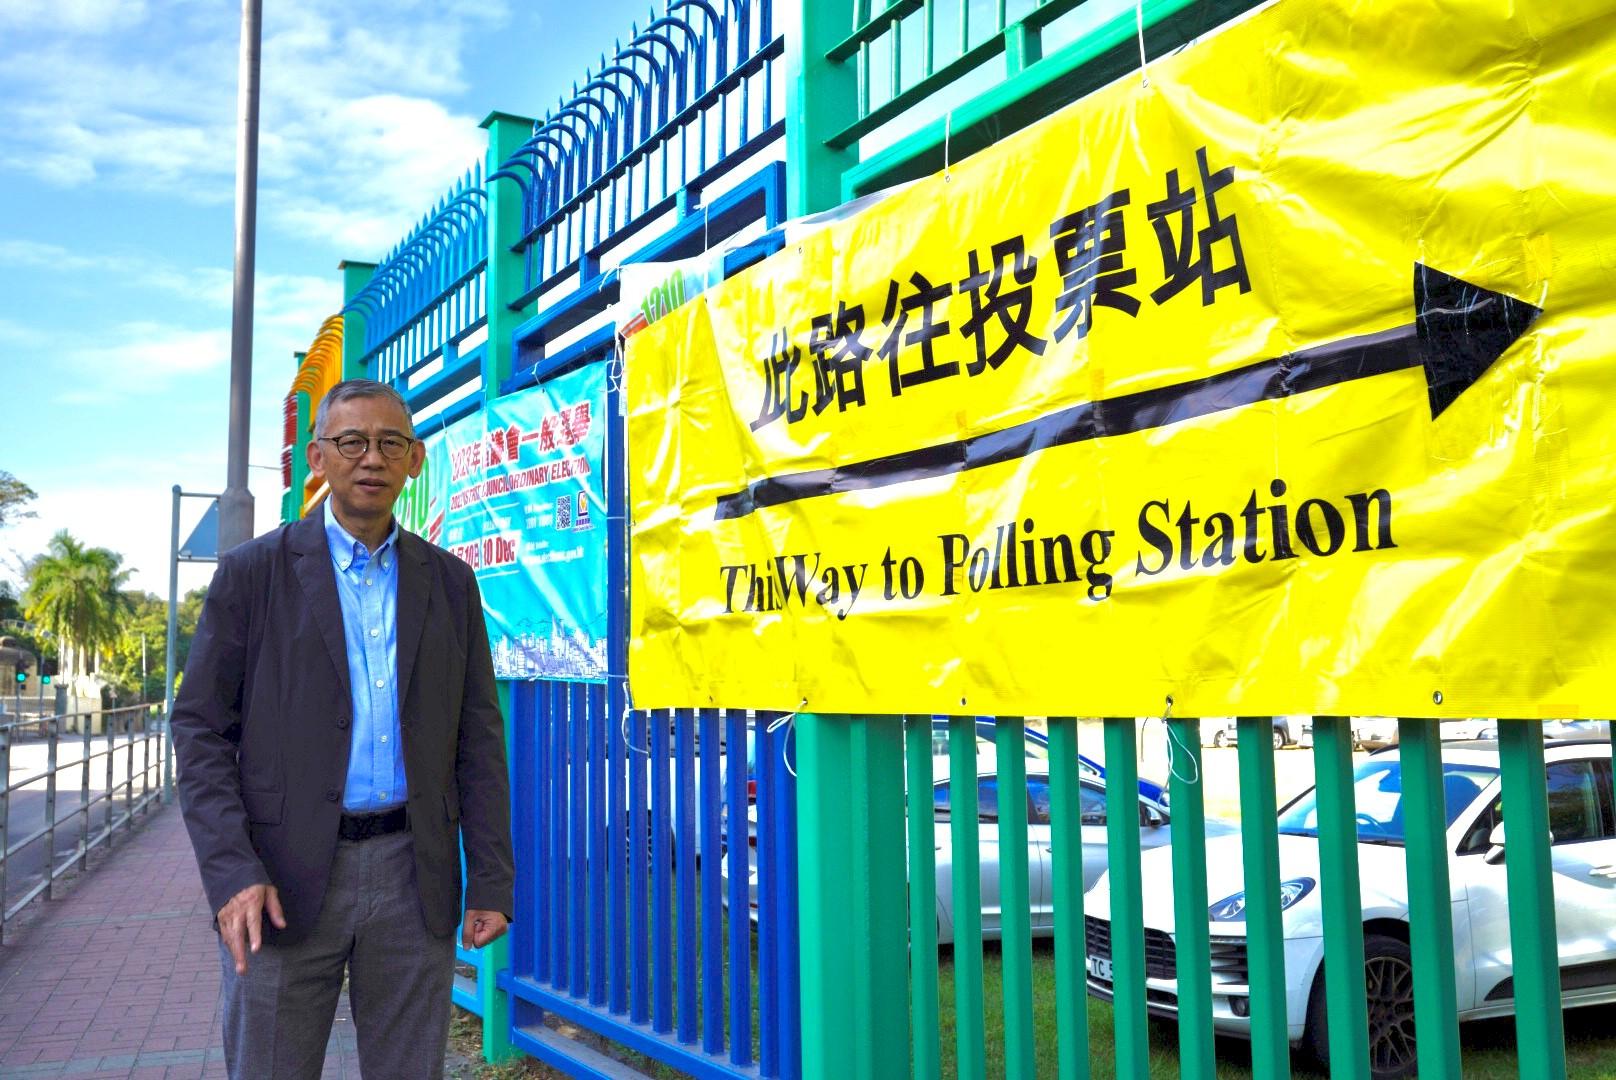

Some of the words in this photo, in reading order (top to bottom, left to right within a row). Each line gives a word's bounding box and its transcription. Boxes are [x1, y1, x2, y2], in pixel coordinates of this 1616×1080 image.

[750, 145, 1254, 431] 此路往投票站
[509, 465, 549, 491] ORDINARY
[496, 537, 515, 564] Dec
[774, 552, 868, 620] Way
[881, 546, 925, 600] to
[940, 518, 1116, 600] Polling
[1135, 479, 1398, 576] Station
